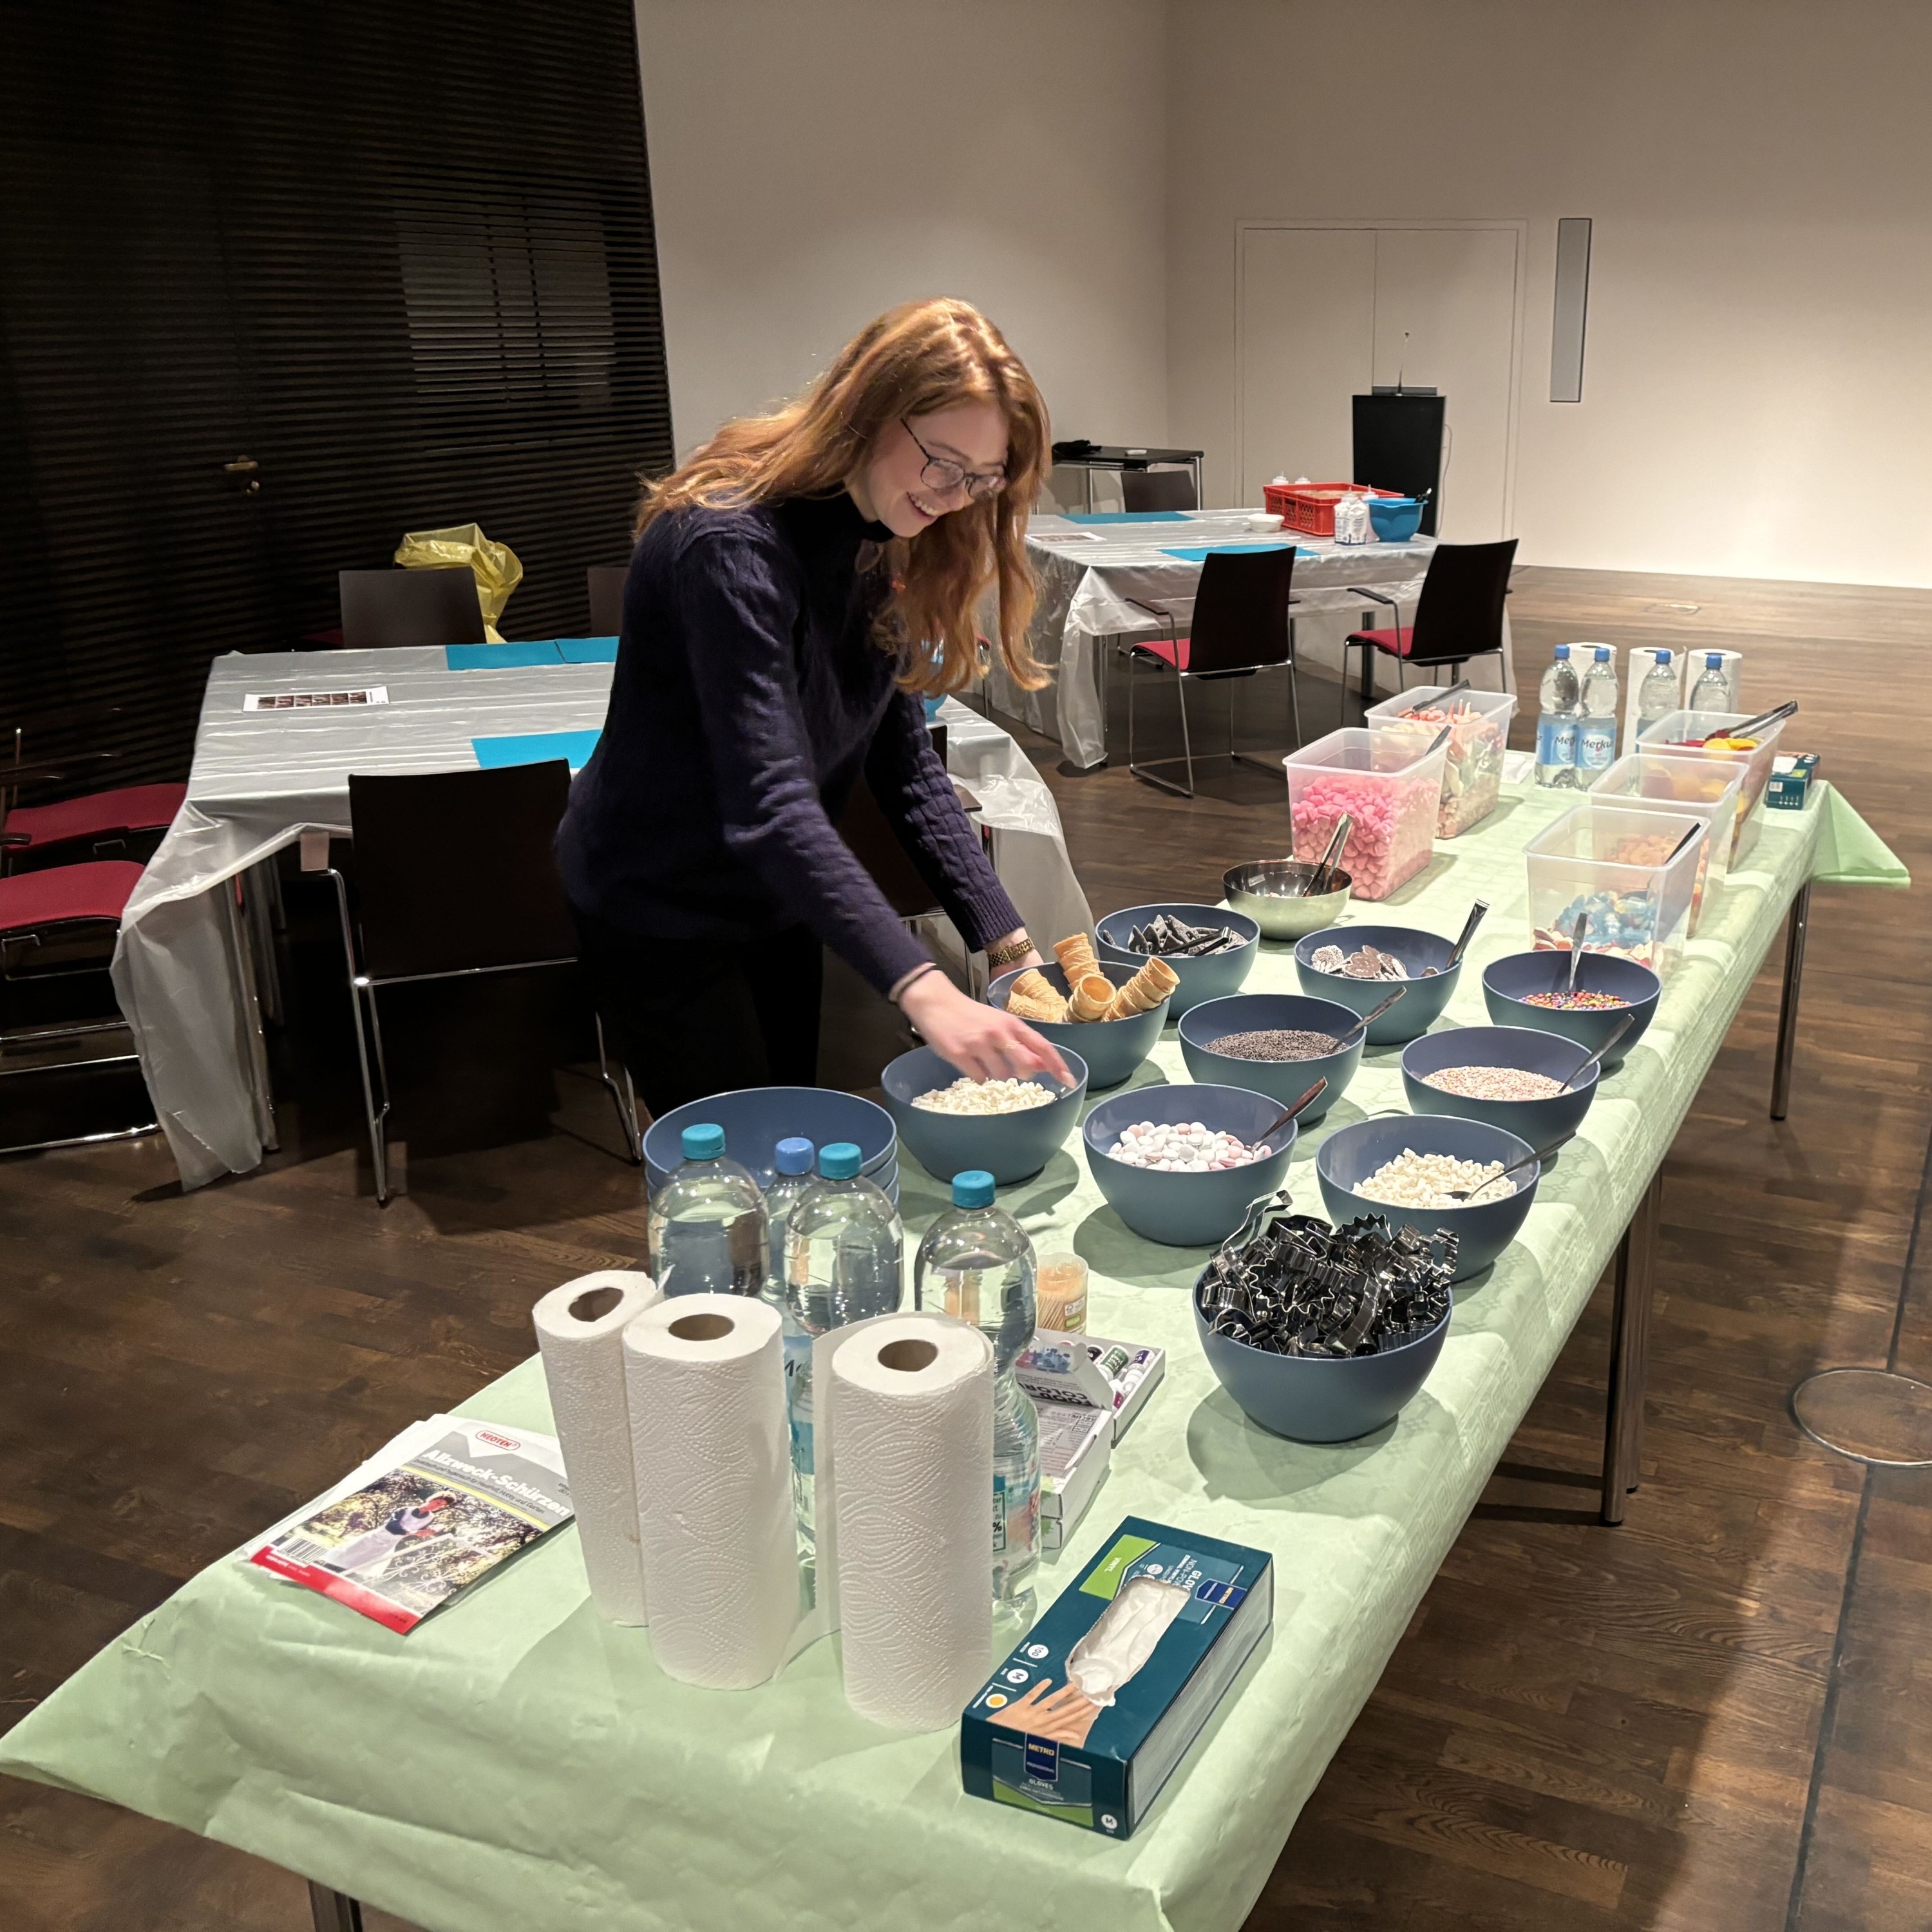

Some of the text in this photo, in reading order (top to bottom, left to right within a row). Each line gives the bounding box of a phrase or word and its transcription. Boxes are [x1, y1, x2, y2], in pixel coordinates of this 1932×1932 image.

[480, 1432, 513, 1448] NEOTEN
[421, 1449, 571, 1517] Allzweck-Schürzen
[1012, 1671, 1025, 1680] M
[1028, 1743, 1056, 1757] METRO
[1028, 1777, 1054, 1790] GLOVES
[1104, 1816, 1114, 1826] M
